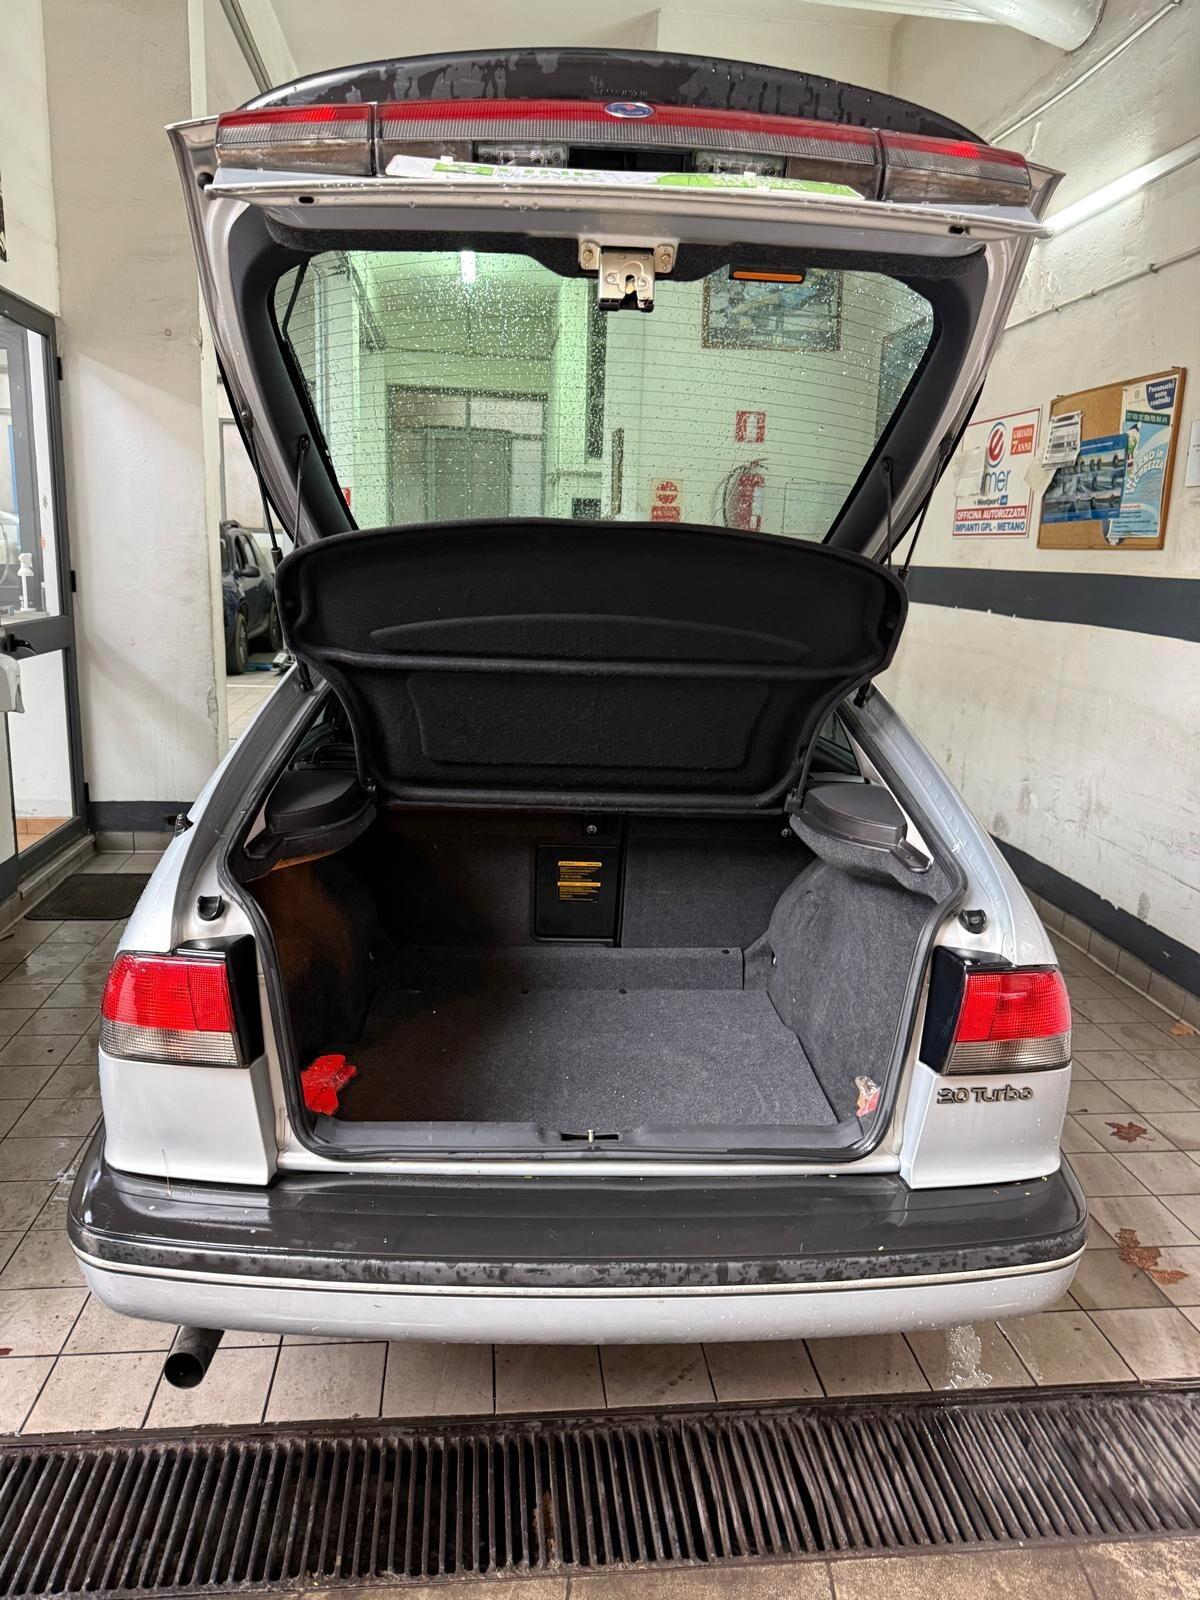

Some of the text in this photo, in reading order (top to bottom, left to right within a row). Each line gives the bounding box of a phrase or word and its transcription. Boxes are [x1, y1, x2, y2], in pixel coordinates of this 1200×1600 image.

[984, 470, 1011, 492] mer
[957, 508, 1026, 521] OFFICINA AUTORIZZATA
[955, 522, 980, 532] IMPIANTI
[980, 522, 992, 532] GPL
[997, 521, 1025, 532] METANO
[971, 1084, 1033, 1102] Turbo
